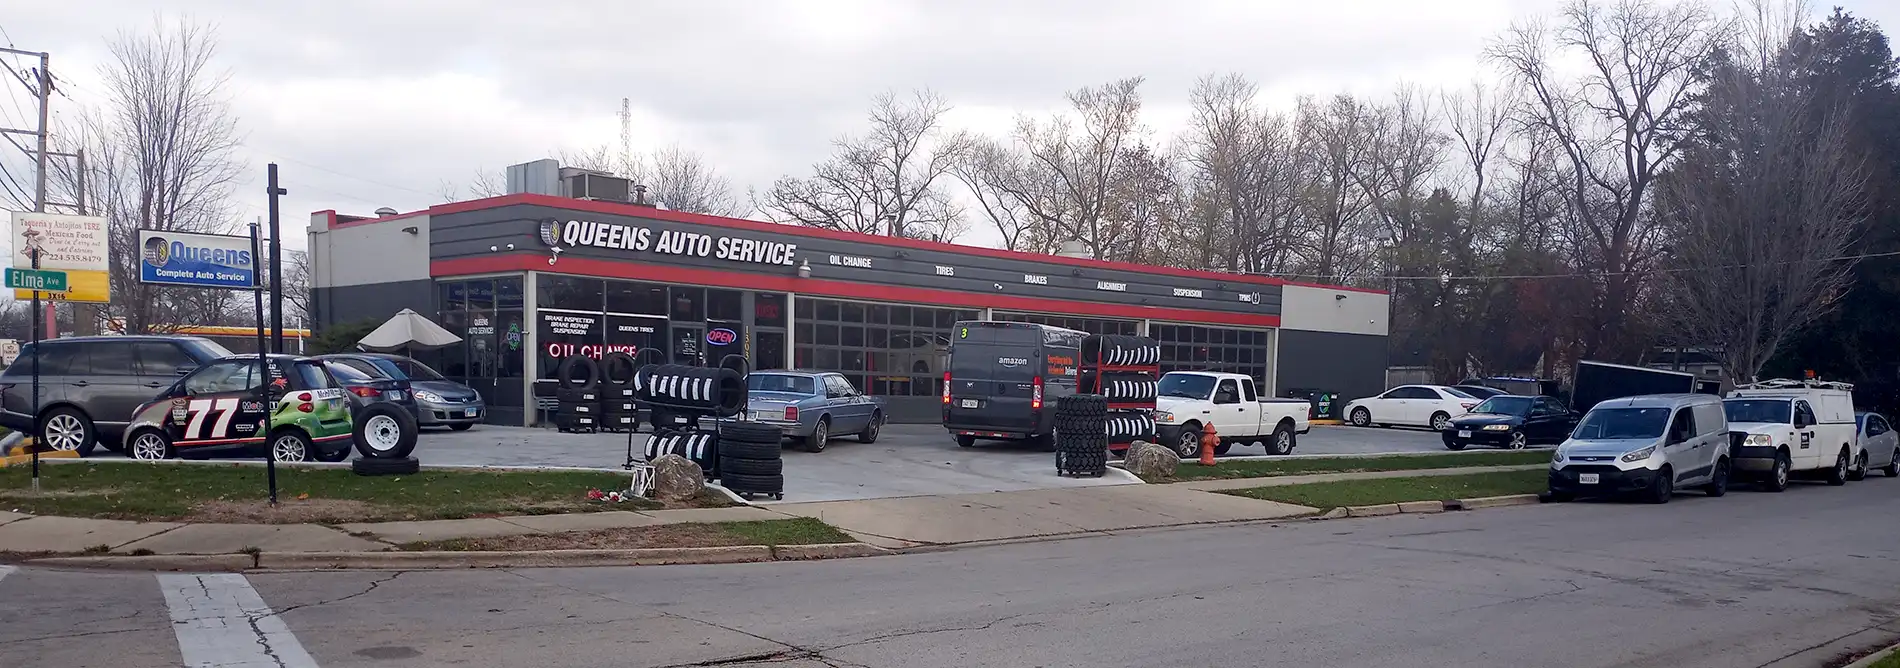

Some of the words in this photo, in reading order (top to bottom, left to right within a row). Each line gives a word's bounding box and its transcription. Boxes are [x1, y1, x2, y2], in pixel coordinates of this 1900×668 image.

[54, 221, 81, 230] Antojitos
[84, 222, 100, 231] TERE
[45, 230, 74, 238] Mexican
[77, 231, 93, 239] Food
[563, 220, 650, 251] QUEENS
[655, 230, 710, 257] AUTO
[716, 237, 796, 266] SERVICE
[170, 240, 250, 266] Queens
[829, 255, 842, 266] OIL
[843, 256, 872, 268] CHANGE
[156, 268, 194, 278] Complete
[196, 271, 214, 279] Auto
[216, 272, 245, 281] Service
[935, 265, 954, 277] TIRES
[12, 271, 44, 288] Elma
[46, 277, 59, 285] Ave
[1024, 274, 1048, 285] BRAKES
[1097, 281, 1127, 292] ALIGNMENT
[1173, 288, 1203, 298] SUSPENSION
[564, 316, 595, 324] INSPECTION
[709, 330, 733, 344] OPEN
[960, 328, 968, 339] 3
[549, 343, 574, 358] OIL
[998, 357, 1028, 365] amazon
[185, 398, 240, 439] 77
